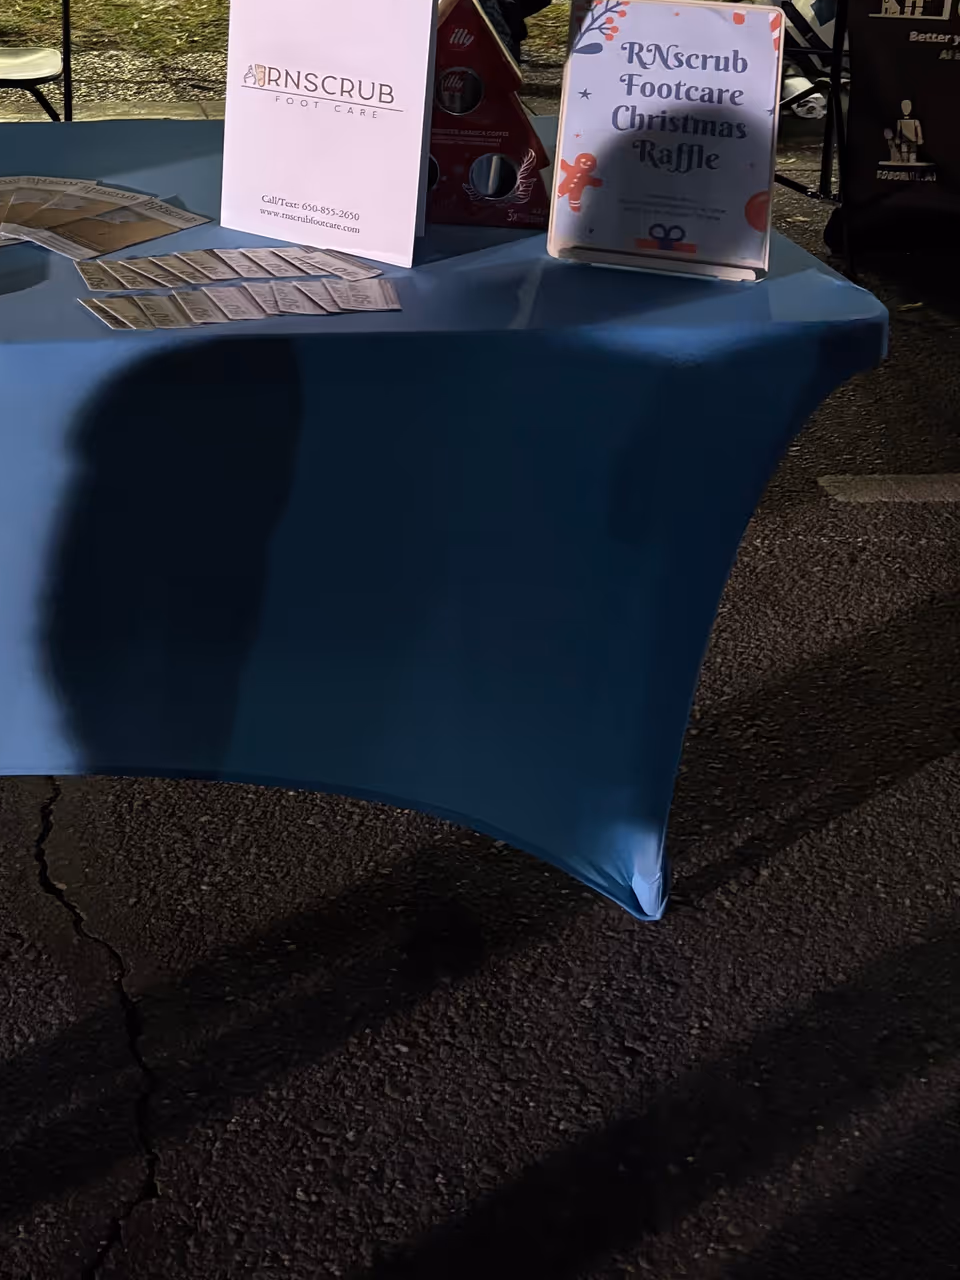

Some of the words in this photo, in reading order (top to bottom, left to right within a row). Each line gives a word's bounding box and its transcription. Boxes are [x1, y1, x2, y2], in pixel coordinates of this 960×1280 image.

[909, 31, 951, 43] Better
[620, 41, 749, 74] RNscrub
[267, 66, 395, 104] RNSCRUB
[620, 73, 744, 106] Footcare
[275, 95, 320, 109] FOOT
[334, 104, 378, 119] CARE
[611, 105, 748, 140] Christmas
[632, 139, 721, 175] Raffle
[259, 207, 360, 234] www.rnscrubfootcare.com
[261, 194, 300, 209] Call/Text:
[301, 202, 360, 221] 650-855-2650
